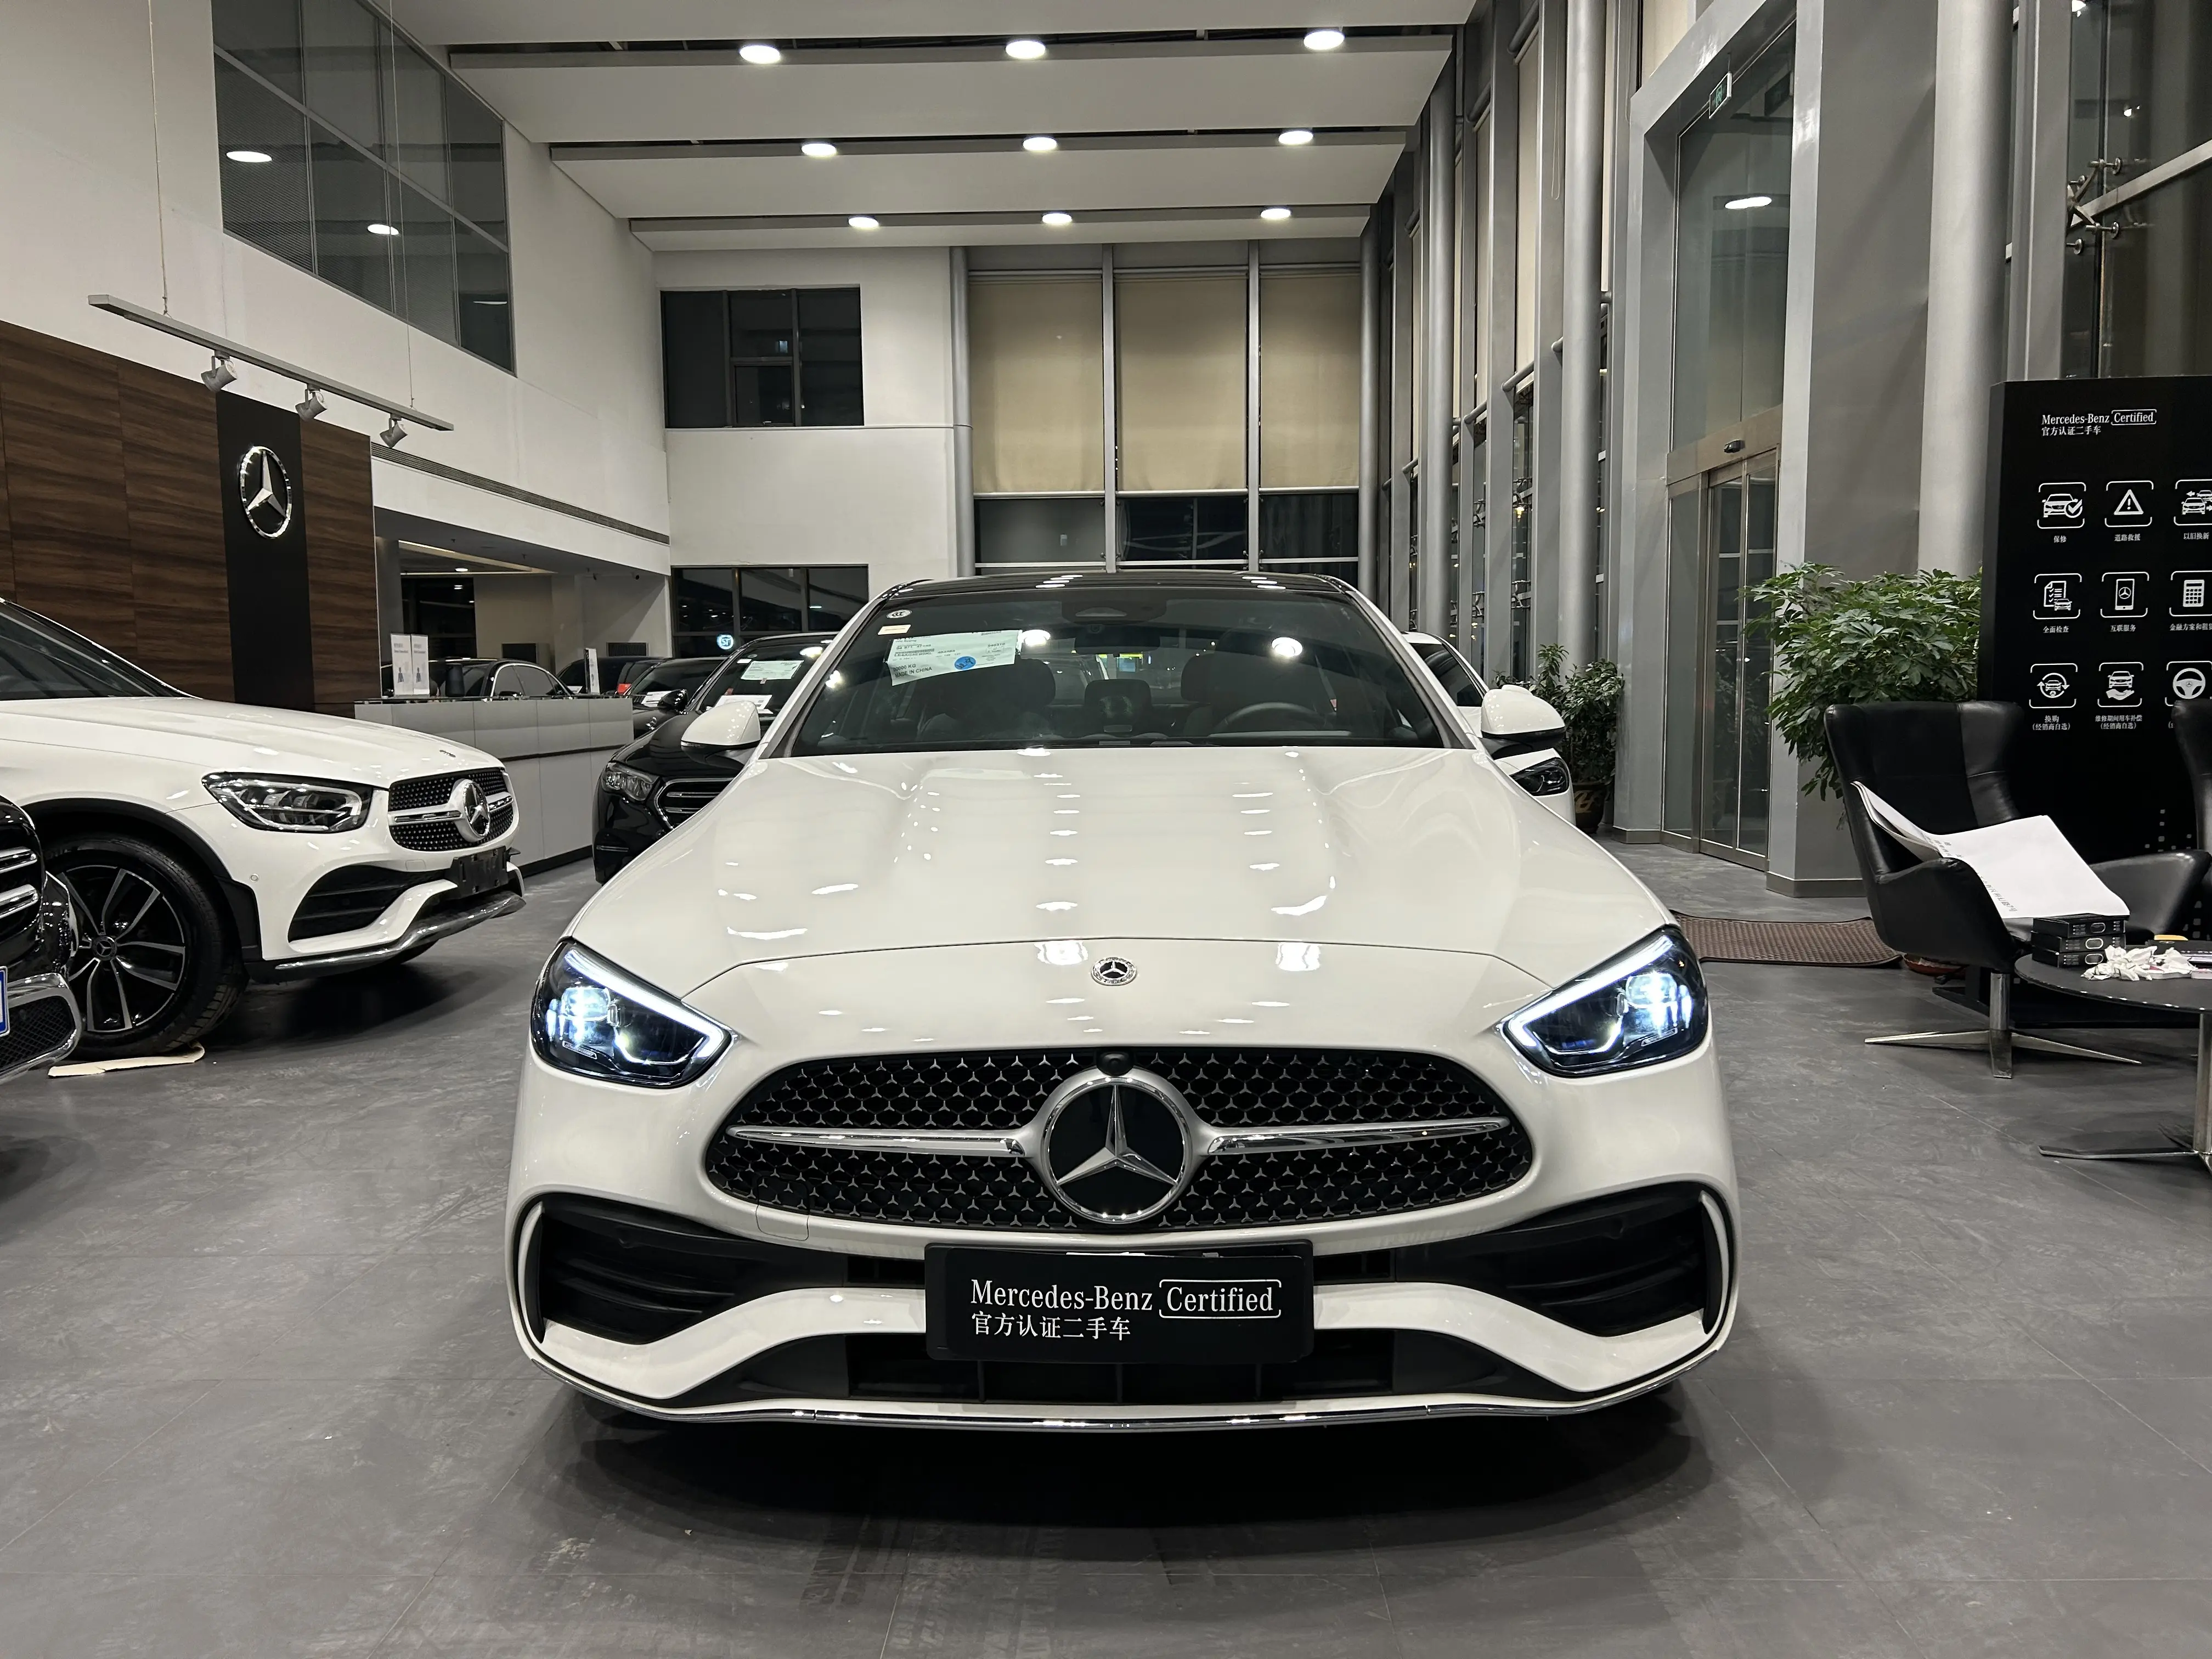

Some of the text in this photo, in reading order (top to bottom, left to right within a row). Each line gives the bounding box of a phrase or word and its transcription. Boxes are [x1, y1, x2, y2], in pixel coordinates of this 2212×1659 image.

[2041, 412, 2154, 425] Mercedes-Benz Certified
[2041, 425, 2101, 437] 官方认证二手车
[2053, 535, 2067, 543] 保修
[2114, 533, 2141, 542] 道路救援
[2183, 532, 2210, 540] 以旧换新
[2043, 625, 2069, 634] 全面检查
[2110, 624, 2136, 632] 互联服务
[970, 1279, 1274, 1313] Mercedes-Benz Certified
[972, 1310, 1131, 1341] 官方认证二手车
